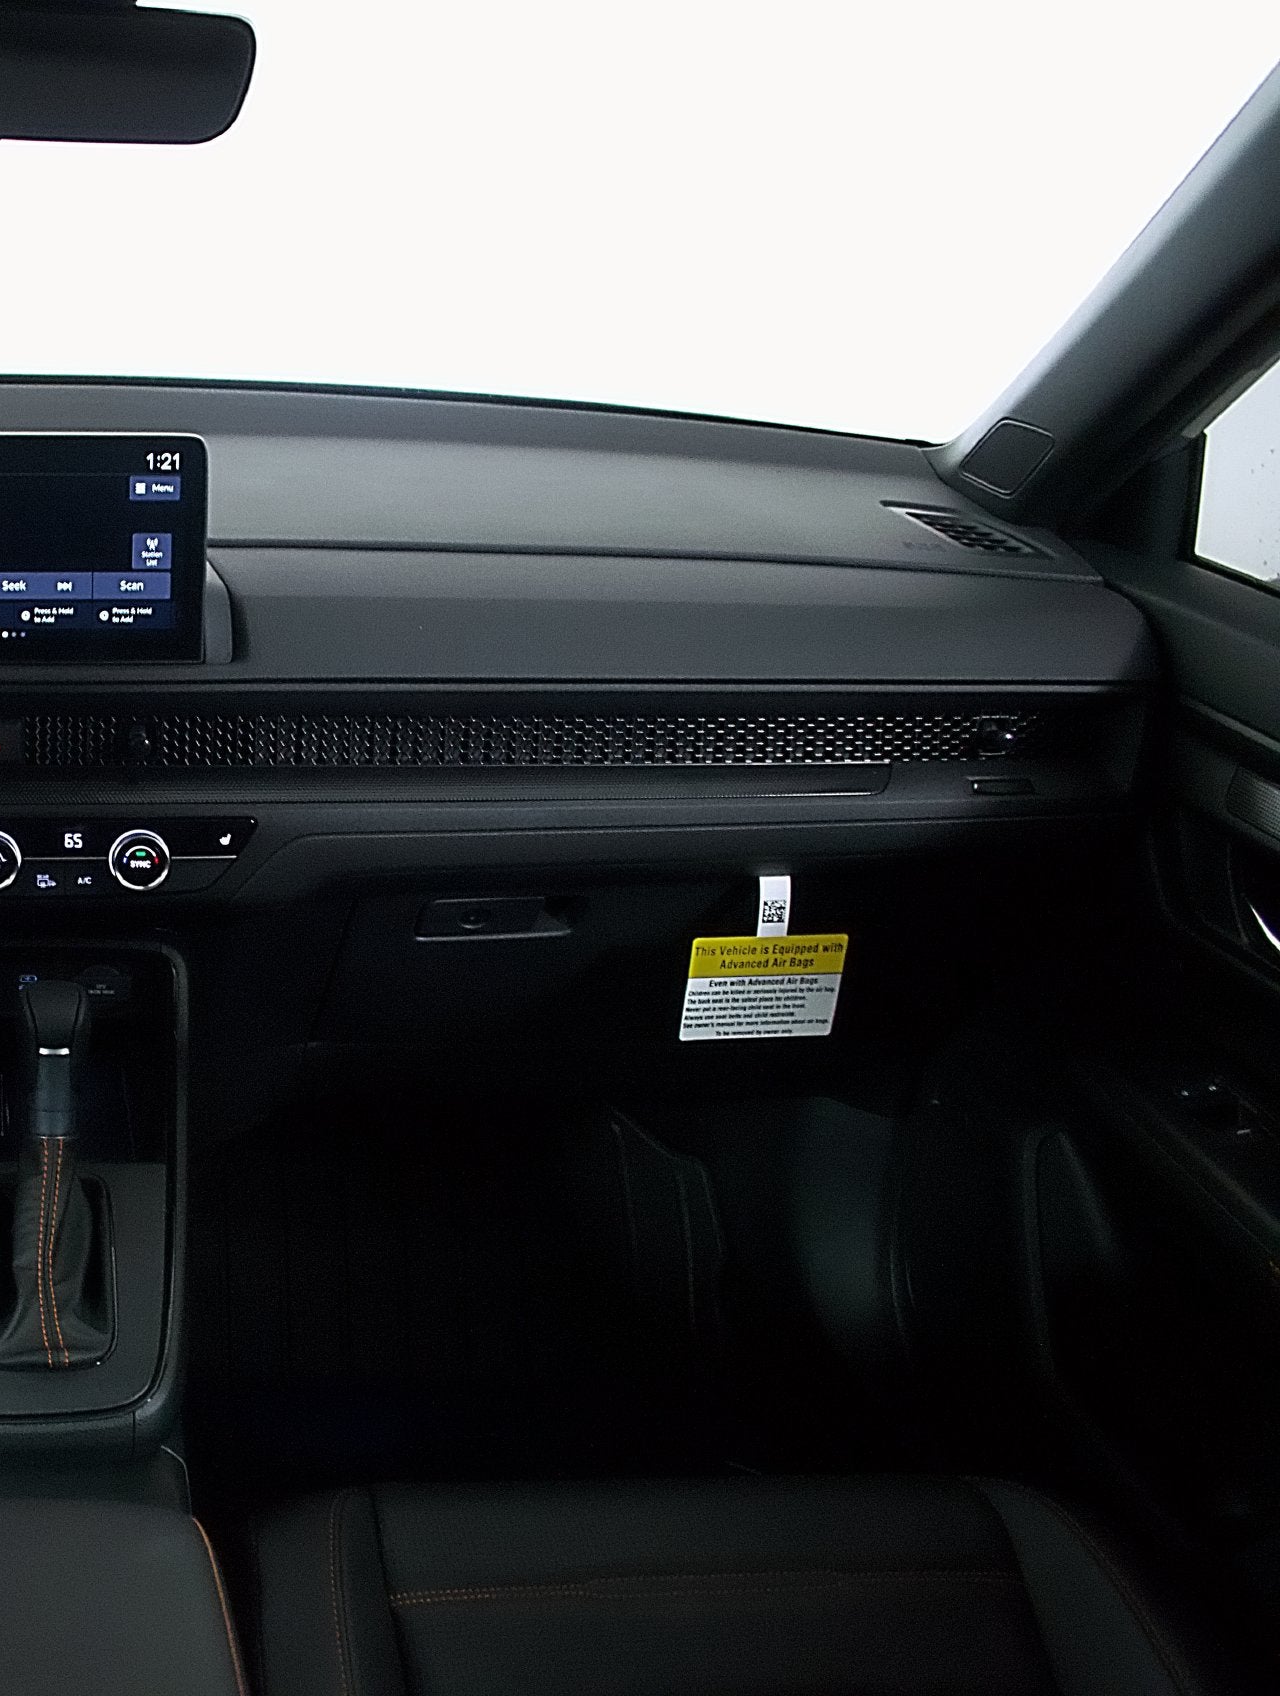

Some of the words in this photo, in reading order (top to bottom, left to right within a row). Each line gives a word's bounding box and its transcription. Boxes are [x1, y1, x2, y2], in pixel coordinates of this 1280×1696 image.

[146, 453, 180, 470] 1:21
[151, 483, 174, 493] Menu
[1, 580, 27, 591] Seek
[120, 580, 144, 591] Scan
[34, 607, 51, 615] Press
[58, 607, 74, 615] Hold
[112, 607, 129, 615] Press
[137, 607, 152, 615] Hold
[64, 833, 83, 848] 65
[130, 860, 151, 868] SYNC
[77, 876, 92, 885] A/C
[695, 947, 717, 956] This
[719, 945, 757, 955] Vehicle
[760, 945, 770, 954] is
[772, 943, 819, 956] Equipped
[822, 943, 844, 953] with
[720, 959, 769, 969] Advanced
[772, 958, 787, 967] Air
[789, 957, 815, 969] Bags
[748, 978, 785, 986] Advanced
[799, 977, 818, 985] Bags
